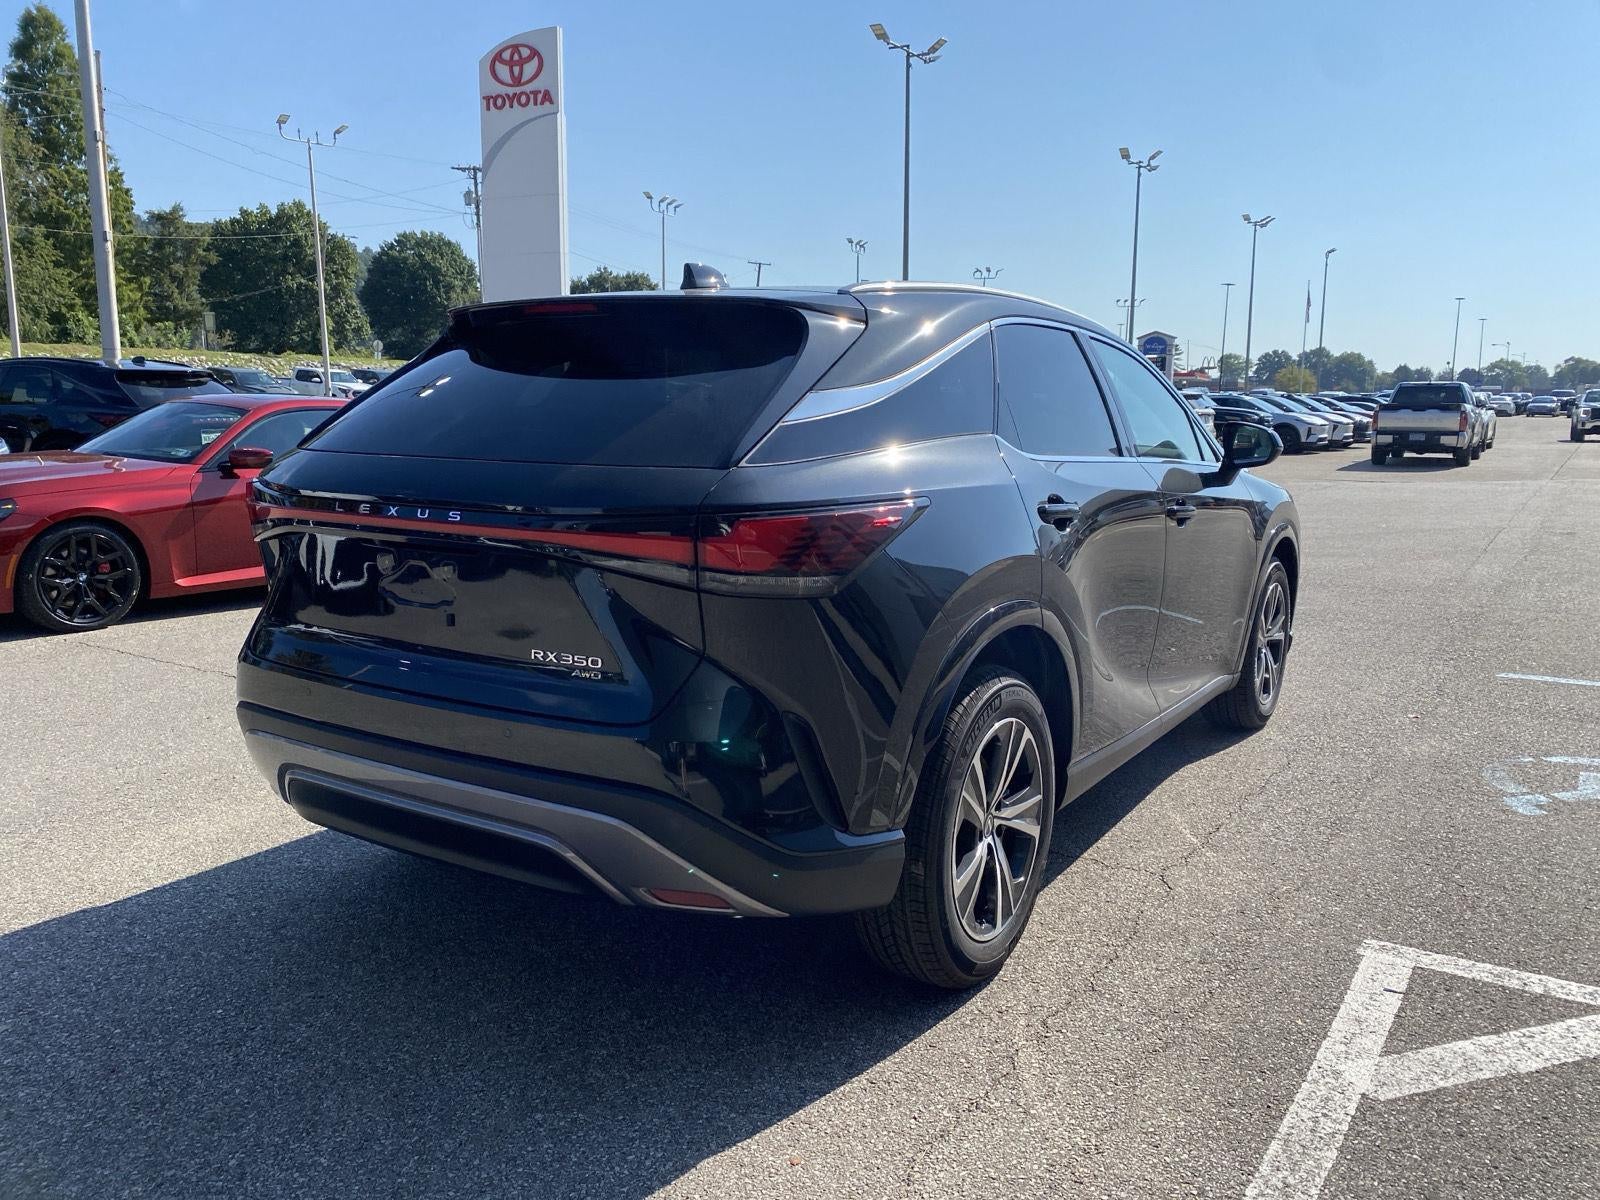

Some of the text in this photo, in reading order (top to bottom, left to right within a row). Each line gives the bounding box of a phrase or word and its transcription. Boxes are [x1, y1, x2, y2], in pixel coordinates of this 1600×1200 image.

[482, 89, 554, 111] TOYOTA
[335, 501, 461, 521] LEXUS
[531, 649, 602, 668] RX350
[571, 669, 601, 680] AWD
